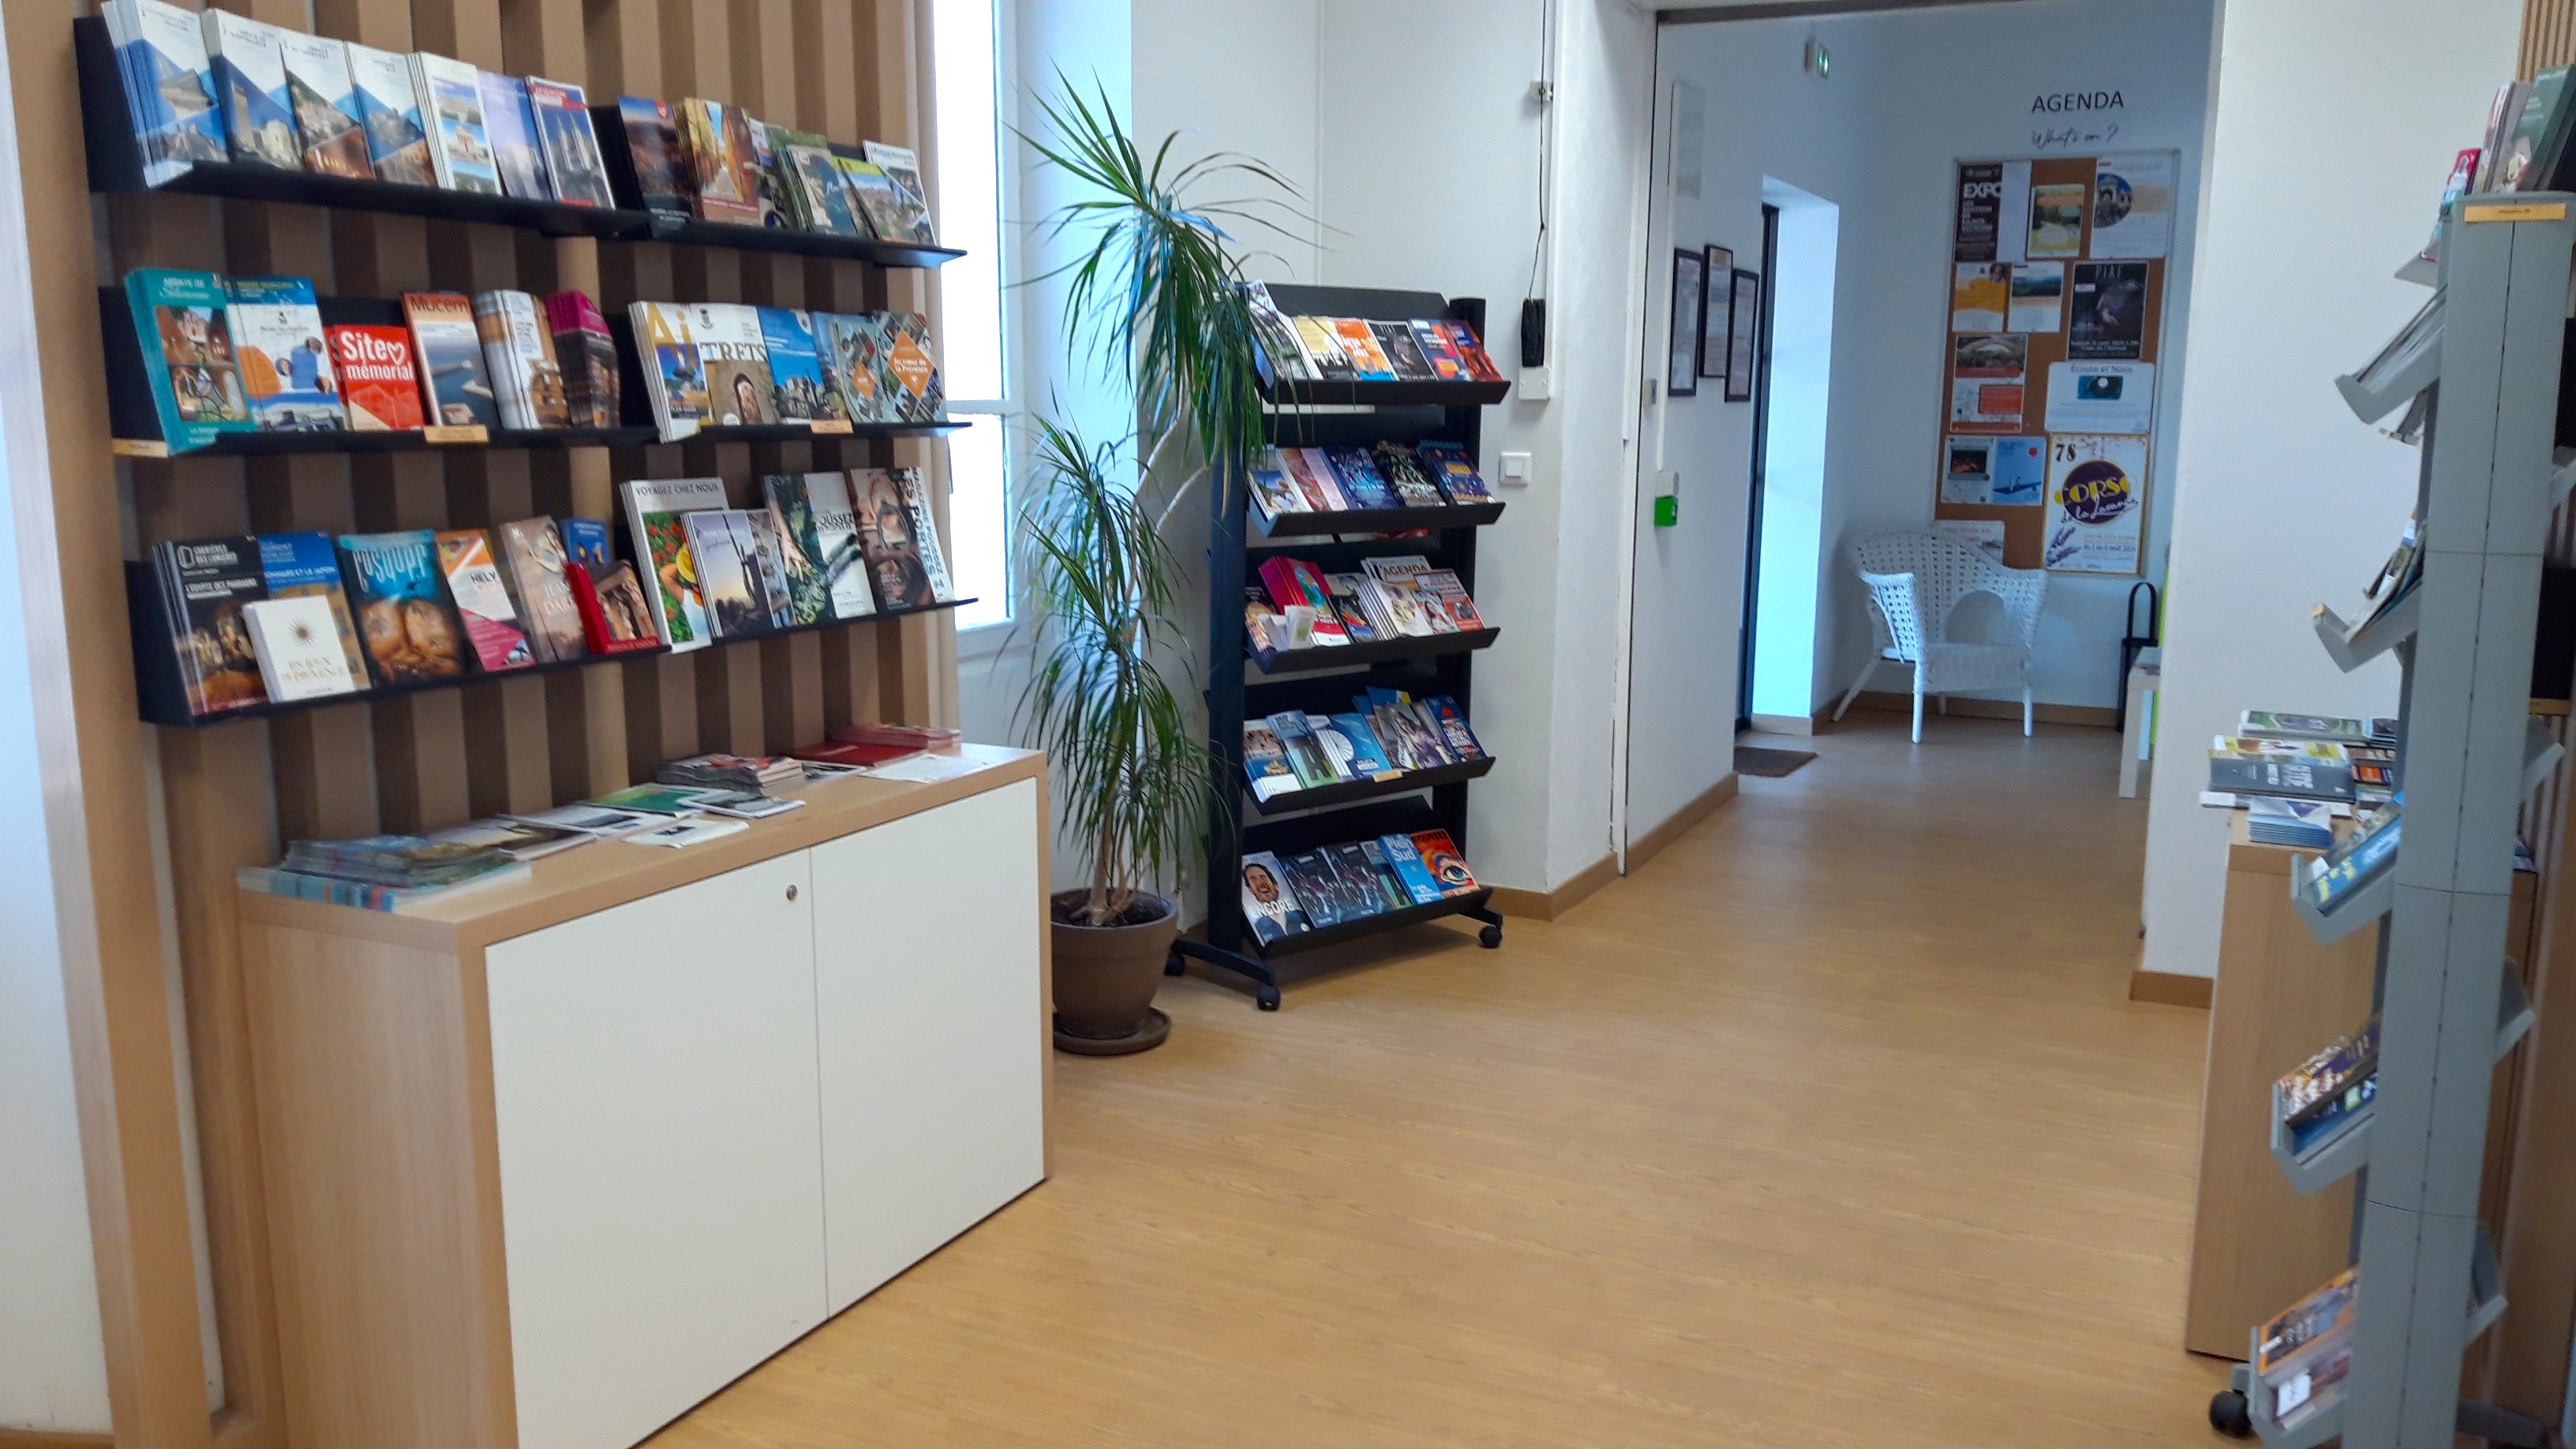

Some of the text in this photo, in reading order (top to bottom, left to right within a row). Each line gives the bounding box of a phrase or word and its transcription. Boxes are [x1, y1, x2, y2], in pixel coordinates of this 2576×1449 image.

[2031, 90, 2124, 113] AGENDA
[410, 295, 470, 313] Mucem
[340, 330, 388, 363] Site
[699, 341, 768, 362] TRETS
[1383, 564, 1427, 575] AGENDA
[1391, 849, 1419, 863] Sud
[1253, 900, 1295, 918] NCORE
